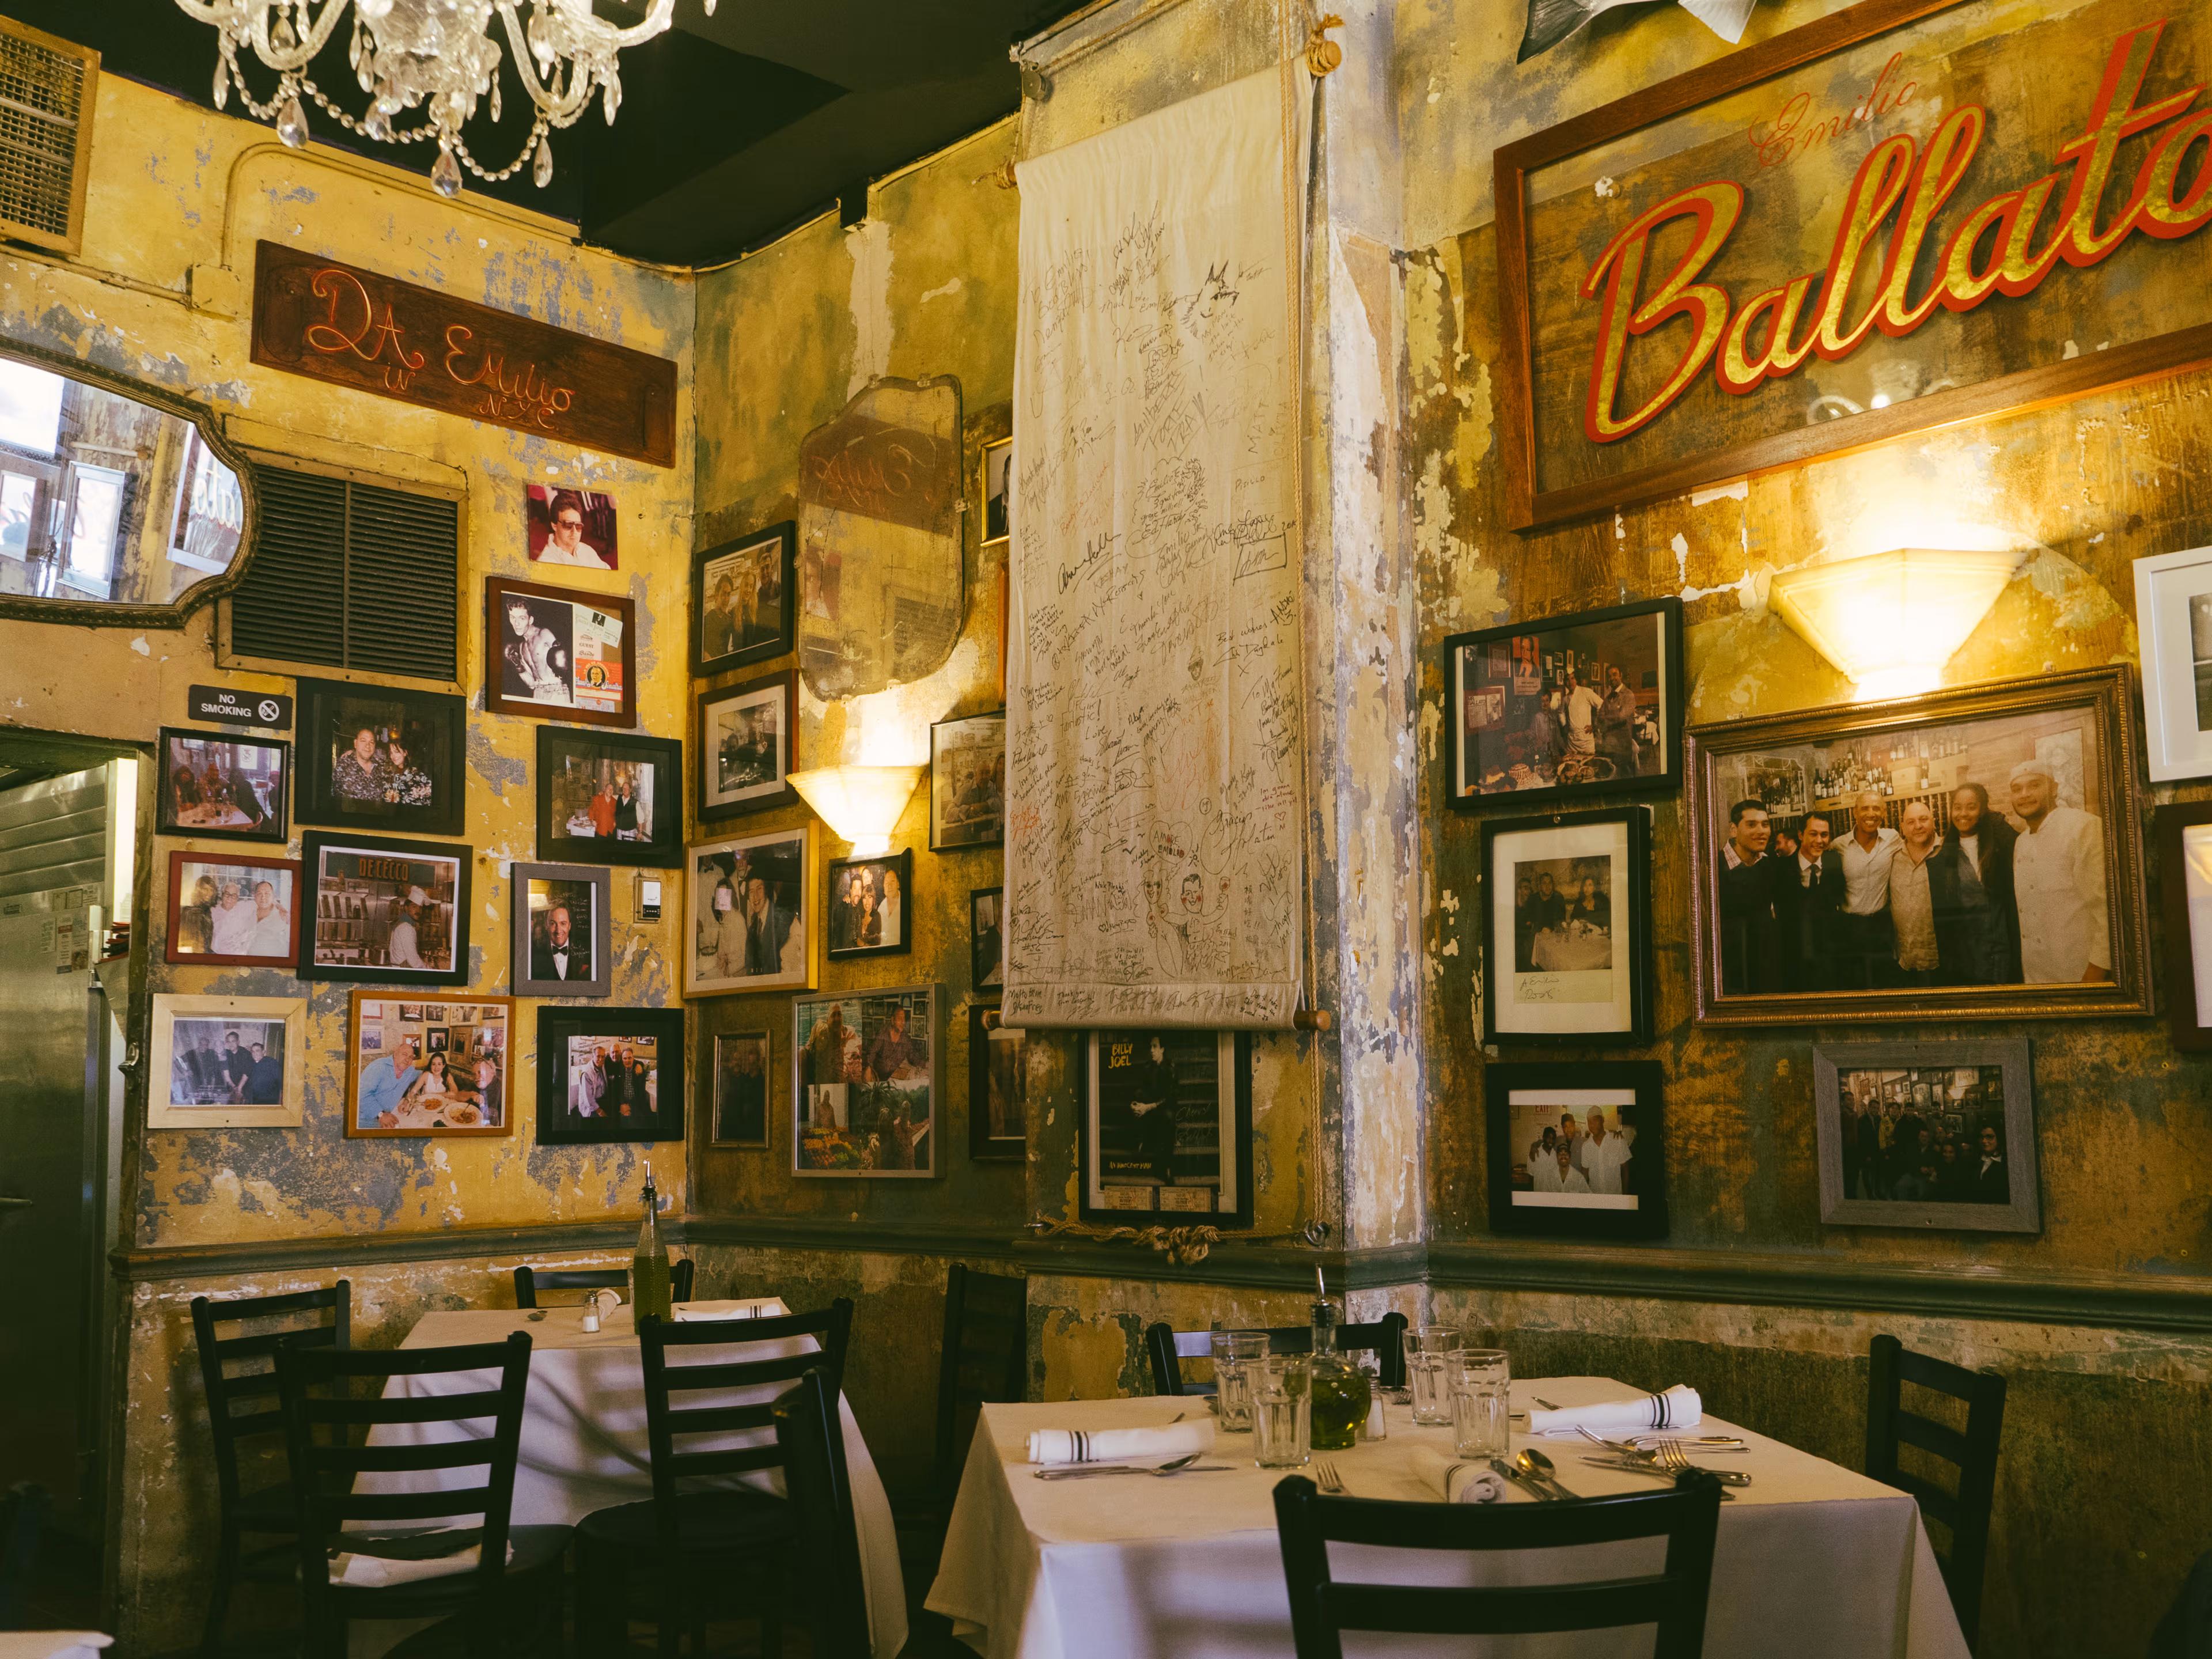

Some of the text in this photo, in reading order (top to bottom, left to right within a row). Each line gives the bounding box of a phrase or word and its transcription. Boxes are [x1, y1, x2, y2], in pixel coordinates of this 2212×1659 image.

[1748, 51, 1917, 168] Emilio
[219, 694, 236, 704] NO
[201, 703, 252, 717] SMOKING
[1112, 1043, 1133, 1056] BILLY
[1108, 1055, 1132, 1069] JOEL
